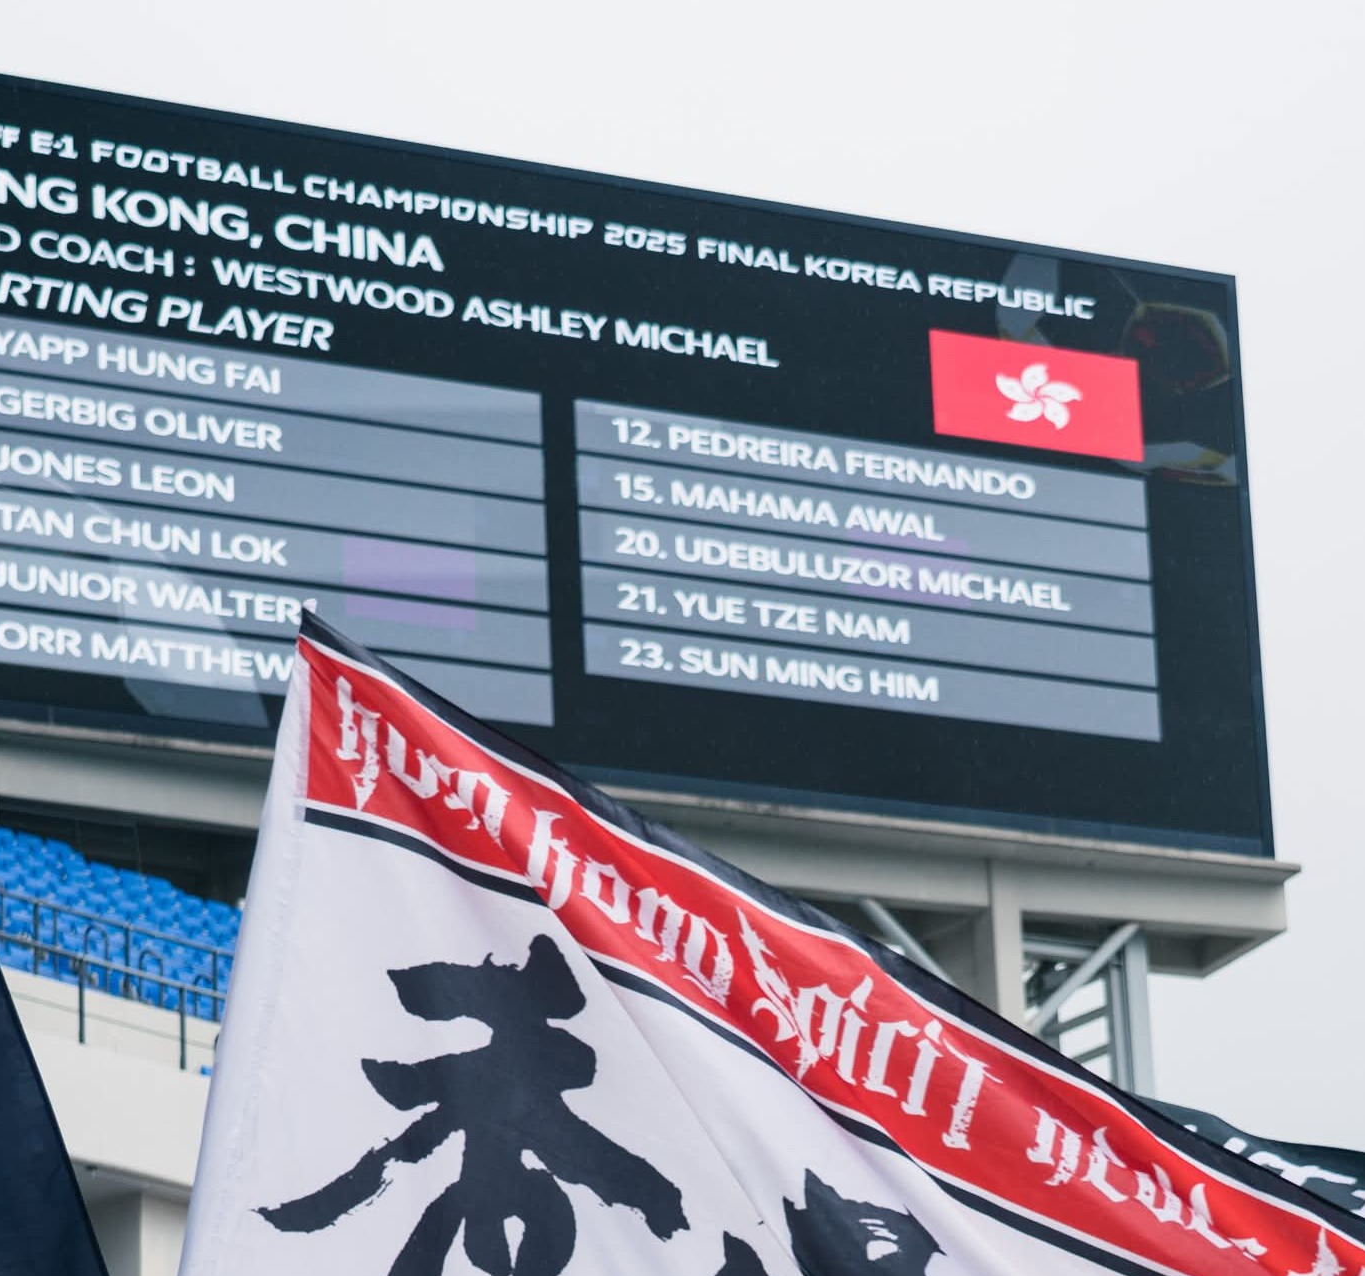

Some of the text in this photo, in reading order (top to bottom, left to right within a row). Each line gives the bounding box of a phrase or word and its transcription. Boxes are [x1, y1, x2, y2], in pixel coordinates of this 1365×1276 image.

[30, 129, 79, 160] E-1
[90, 140, 296, 194] FOOTBALL
[303, 174, 594, 239] CHAMPIONSHIP
[604, 222, 688, 256] 2025
[698, 237, 799, 274] FINAL
[805, 254, 922, 294] KOREA
[928, 274, 1097, 320] REPUBLIC
[91, 183, 264, 249] KONG,
[274, 214, 445, 272] CHINA
[30, 229, 175, 277] COACH
[211, 256, 455, 319] WESTWOOD
[462, 296, 608, 342] ASHLEY
[614, 318, 781, 368] MICHAEL
[157, 296, 335, 351] PLAYER
[97, 342, 216, 386] HUNG
[224, 362, 282, 395] FAI
[144, 407, 283, 452] OLIVER
[611, 417, 1036, 500] 12. PEDREIRA FERNANDO
[130, 463, 235, 502] LEON
[613, 473, 946, 542] 15. MAHAMA AWAL
[83, 515, 202, 555] CHUN
[211, 531, 288, 567] LOK
[615, 528, 1072, 612] 20. UDEBULUZOR MICHAEL
[146, 578, 302, 625] WALTER
[617, 583, 911, 646] 21. YUE TZE NAM
[91, 632, 296, 682] MATTHEW
[618, 639, 939, 703] 23. SUN MING HIM
